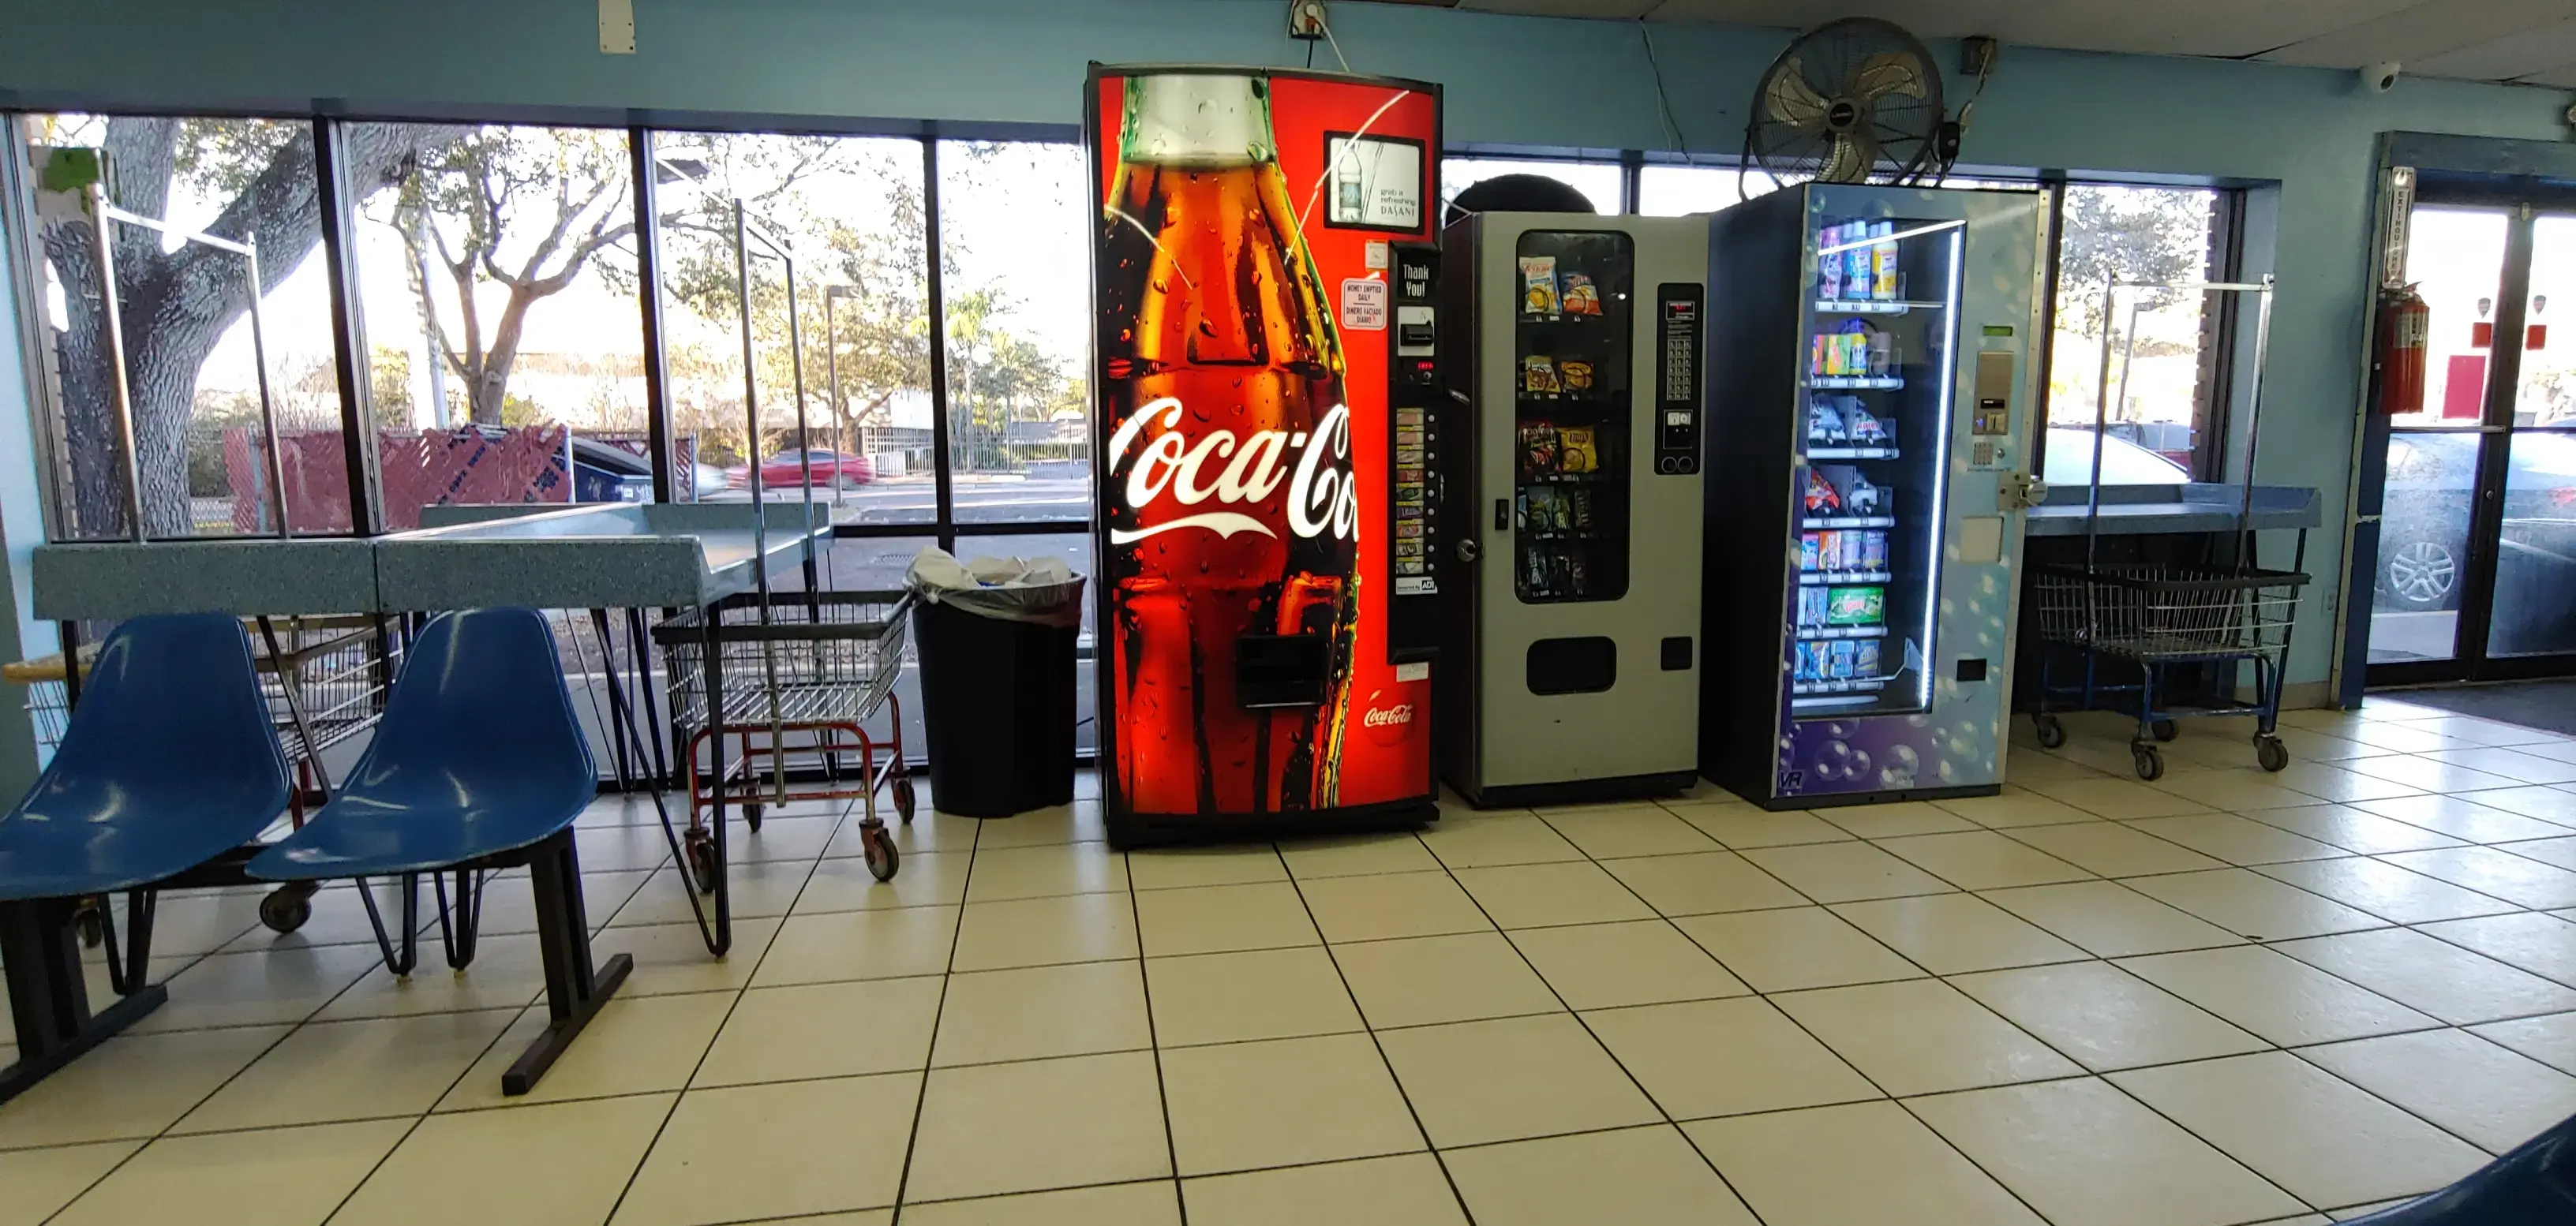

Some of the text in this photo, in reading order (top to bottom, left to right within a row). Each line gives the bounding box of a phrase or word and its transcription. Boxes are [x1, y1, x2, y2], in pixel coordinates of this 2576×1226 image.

[1381, 196, 1415, 206] refreshing
[1381, 206, 1414, 216] DASANI
[1403, 264, 1428, 280] Thank
[1406, 281, 1425, 297] You!
[1363, 307, 1382, 316] VACIADO
[1364, 705, 1413, 727] Coca-Cola
